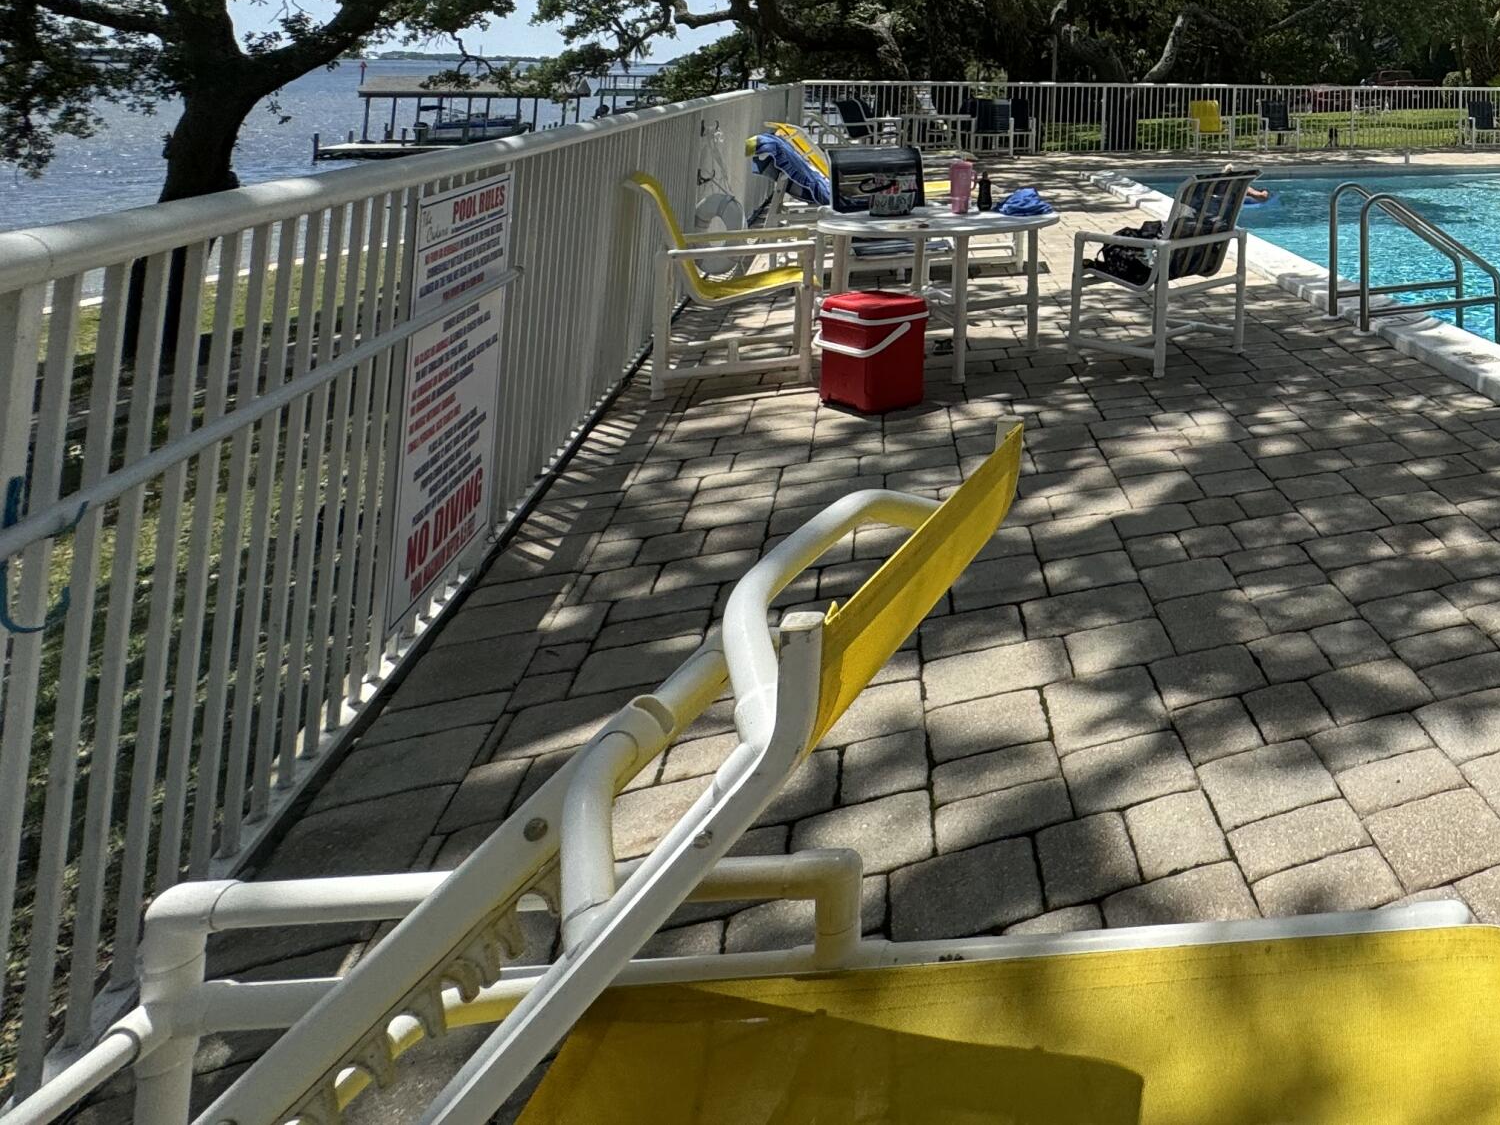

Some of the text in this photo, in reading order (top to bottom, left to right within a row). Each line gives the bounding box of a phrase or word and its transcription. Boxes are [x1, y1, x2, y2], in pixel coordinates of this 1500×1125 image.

[452, 194, 477, 224] POOL
[478, 185, 506, 210] RULES
[404, 520, 430, 581] NO
[432, 467, 483, 553] DIVING
